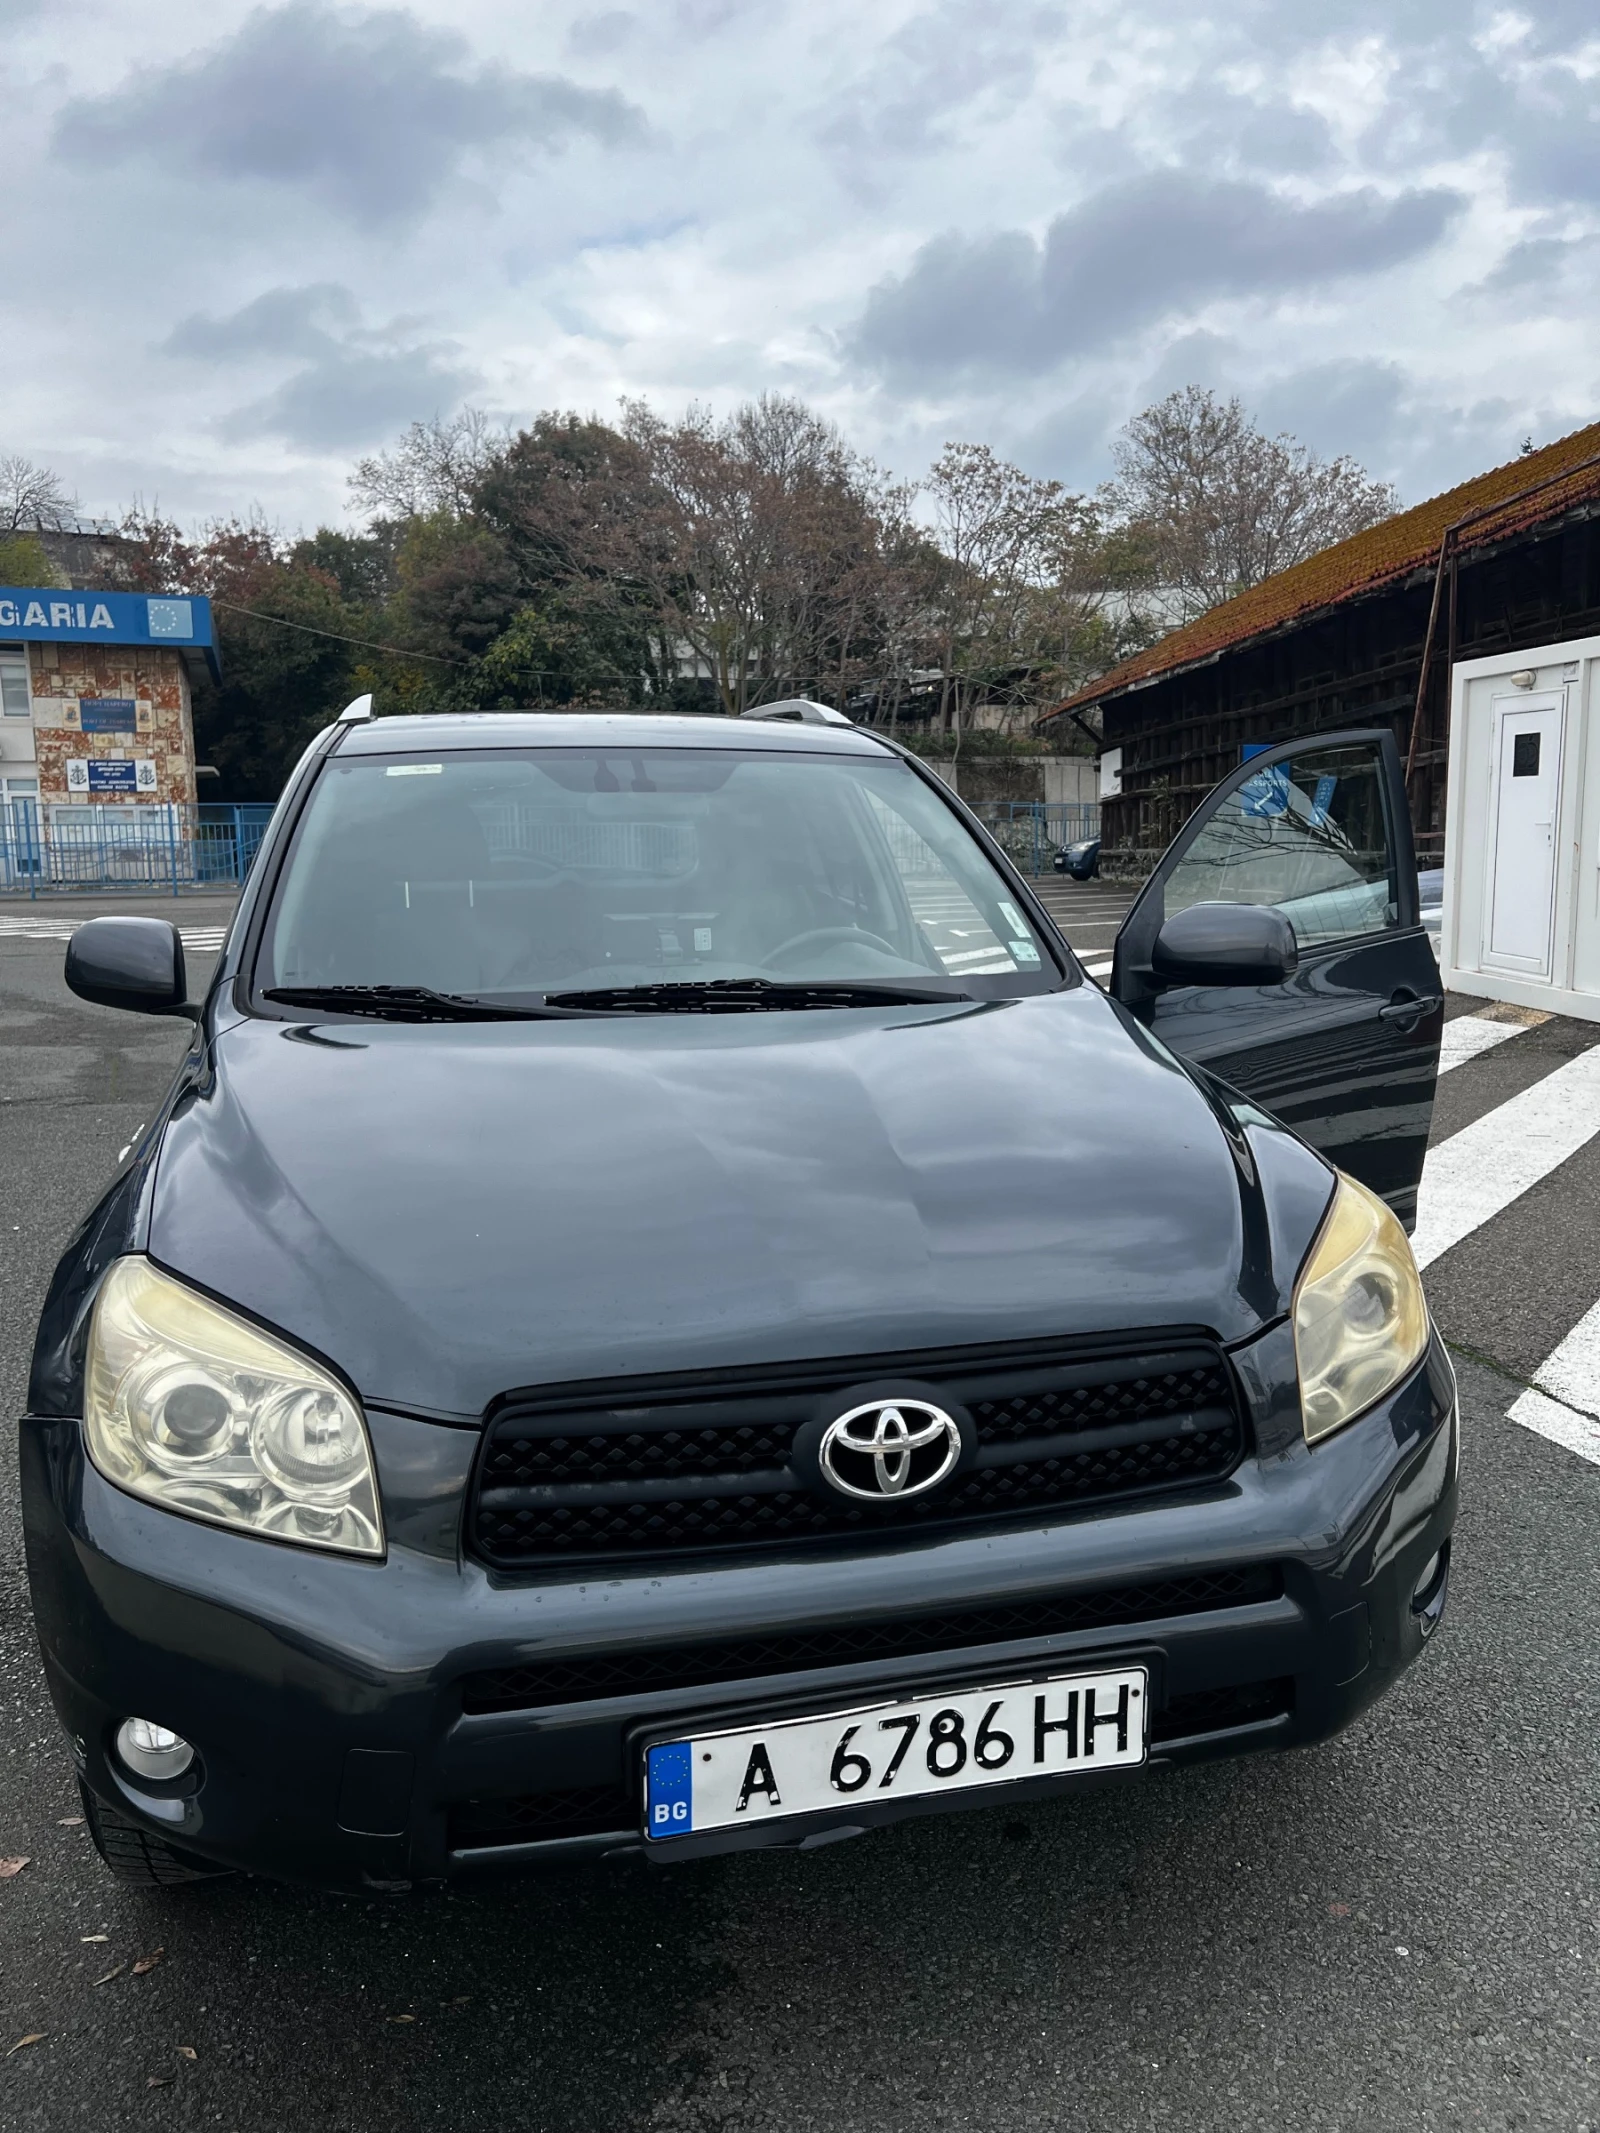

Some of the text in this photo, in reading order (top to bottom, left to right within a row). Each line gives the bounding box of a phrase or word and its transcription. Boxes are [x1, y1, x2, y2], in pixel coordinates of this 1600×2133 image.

[735, 1683, 1130, 1812] A 6786 HH
[654, 1801, 688, 1824] BG
